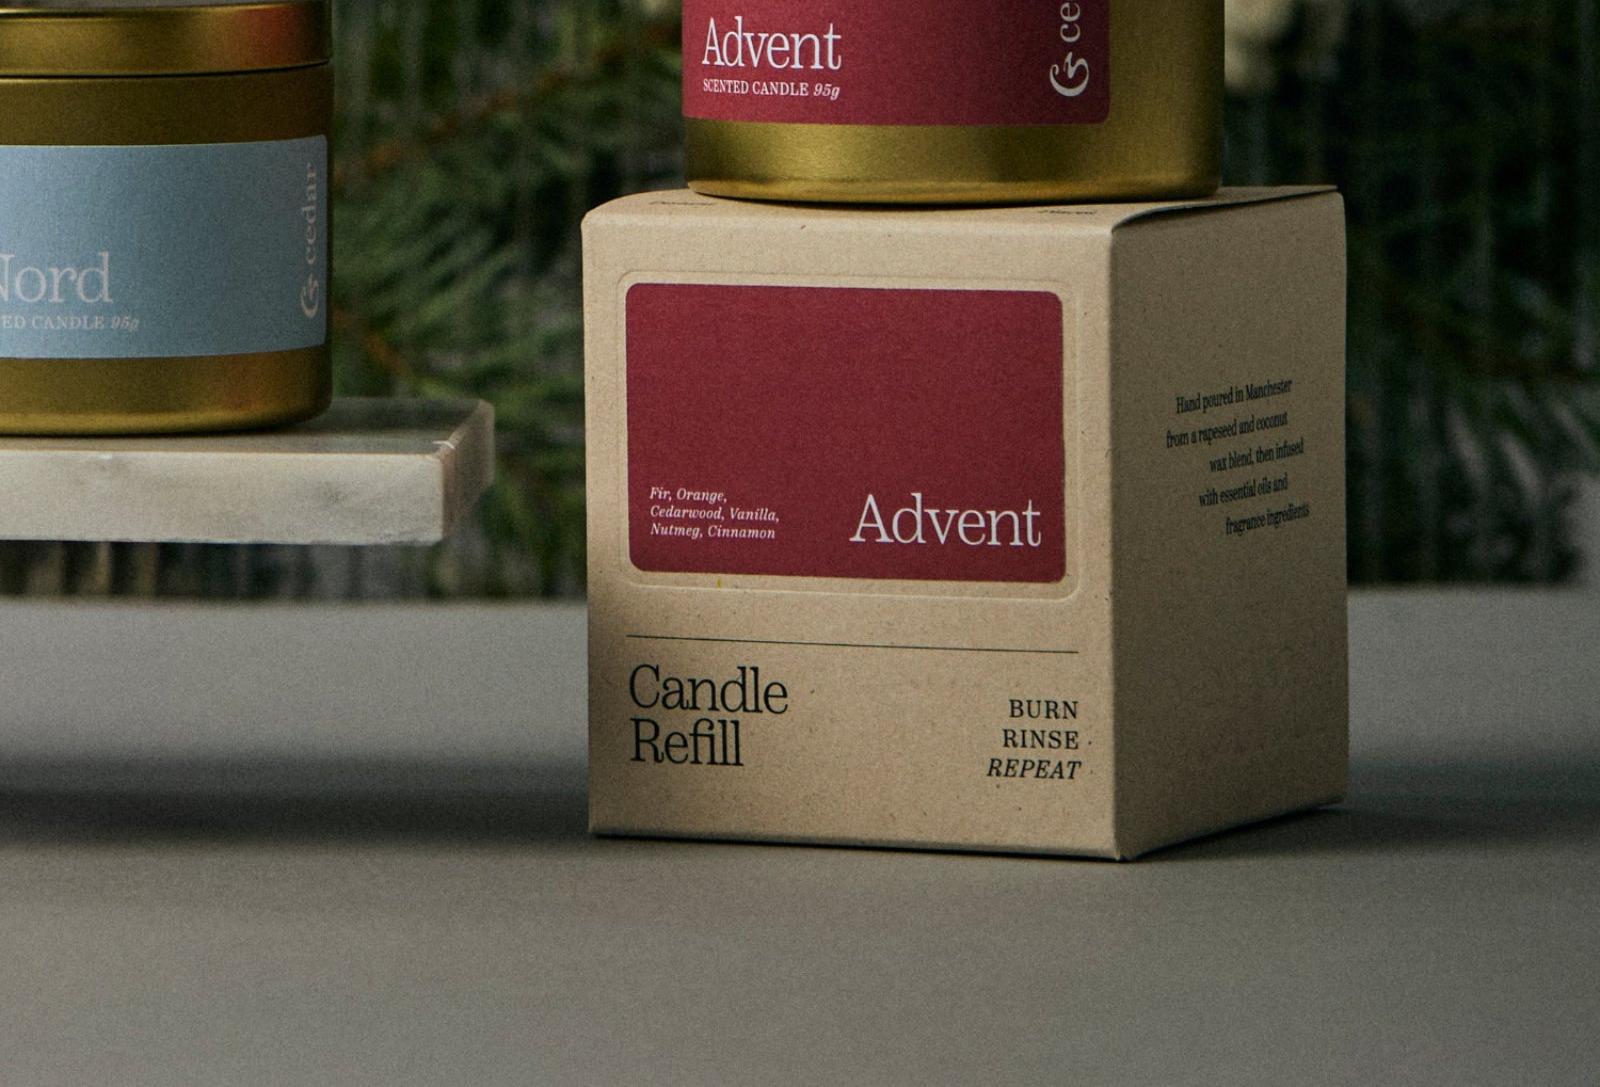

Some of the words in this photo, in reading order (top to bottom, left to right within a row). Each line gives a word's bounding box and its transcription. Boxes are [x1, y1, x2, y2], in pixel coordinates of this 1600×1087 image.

[701, 15, 842, 70] Advent
[702, 78, 750, 95] SCENTED
[752, 80, 809, 97] CANDLE
[812, 82, 841, 102] 95g
[300, 162, 318, 266] cedar
[31, 314, 106, 331] CANDLE
[1175, 392, 1201, 415] Hand
[1202, 386, 1234, 414] poured
[1235, 386, 1244, 403] in
[1245, 378, 1293, 400] Manchester
[1165, 429, 1190, 449] from
[1191, 431, 1197, 445] a
[1198, 417, 1237, 446] rapeseed
[1238, 415, 1255, 434] and
[1256, 411, 1288, 432] coconut
[1209, 458, 1228, 473] wax
[1255, 446, 1275, 464] then
[1275, 437, 1305, 460] infused
[649, 486, 673, 502] Fir,
[675, 487, 728, 504] Orange,
[1199, 487, 1219, 507] with
[1219, 479, 1257, 504] essential
[1257, 476, 1272, 495] oils
[1272, 472, 1288, 492] and
[650, 504, 725, 522] Cedarwood,
[730, 507, 780, 523] Vanilla,
[650, 522, 703, 540] Nutmeg,
[707, 524, 776, 539] Cinnamon
[848, 491, 1042, 548] Advent
[1225, 514, 1266, 538] fragrance
[1266, 501, 1310, 530] ingredients
[628, 663, 788, 715] Candle
[1009, 698, 1080, 720] BURN
[628, 717, 744, 767] Refill
[1002, 728, 1080, 751] RINSE
[986, 757, 1083, 781] REPEAT
